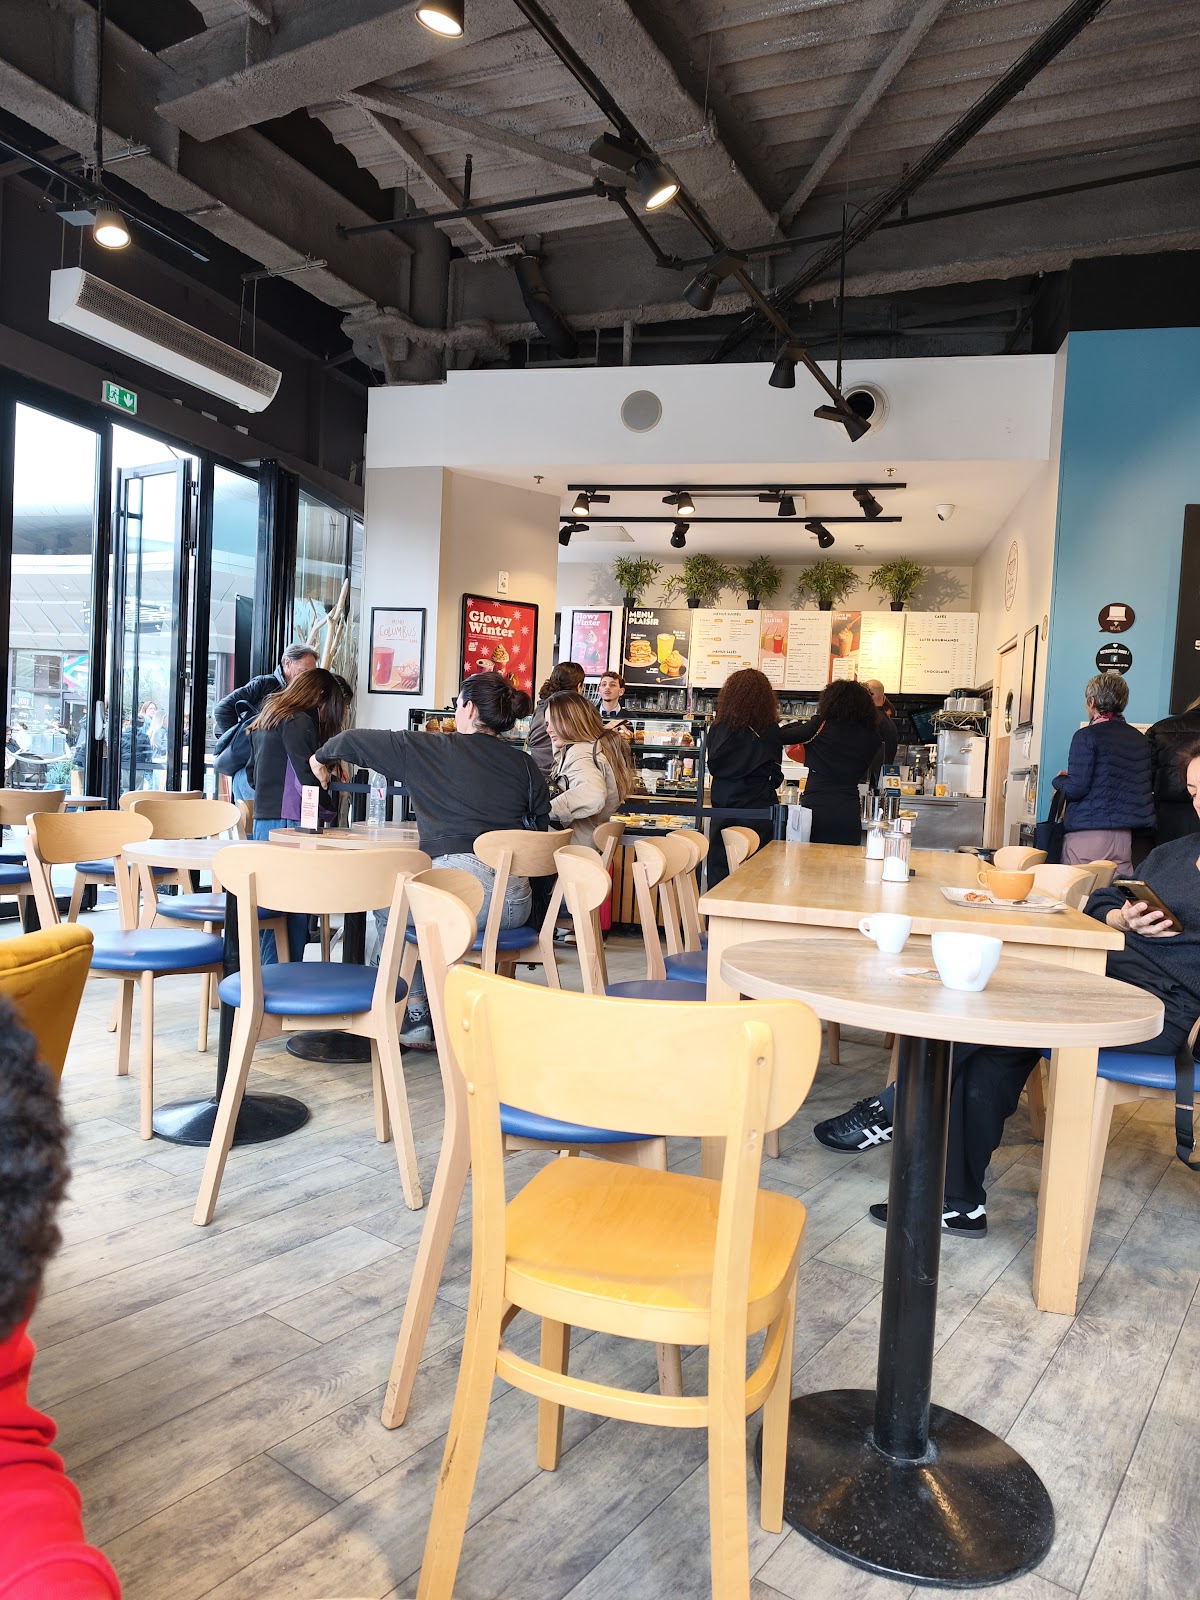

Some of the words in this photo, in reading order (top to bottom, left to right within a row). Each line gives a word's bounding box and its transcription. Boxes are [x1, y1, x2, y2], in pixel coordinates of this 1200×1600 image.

[469, 610, 512, 628] Glowy
[628, 617, 659, 626] PLAISIR
[468, 621, 515, 638] Winter
[886, 778, 899, 787] 13
